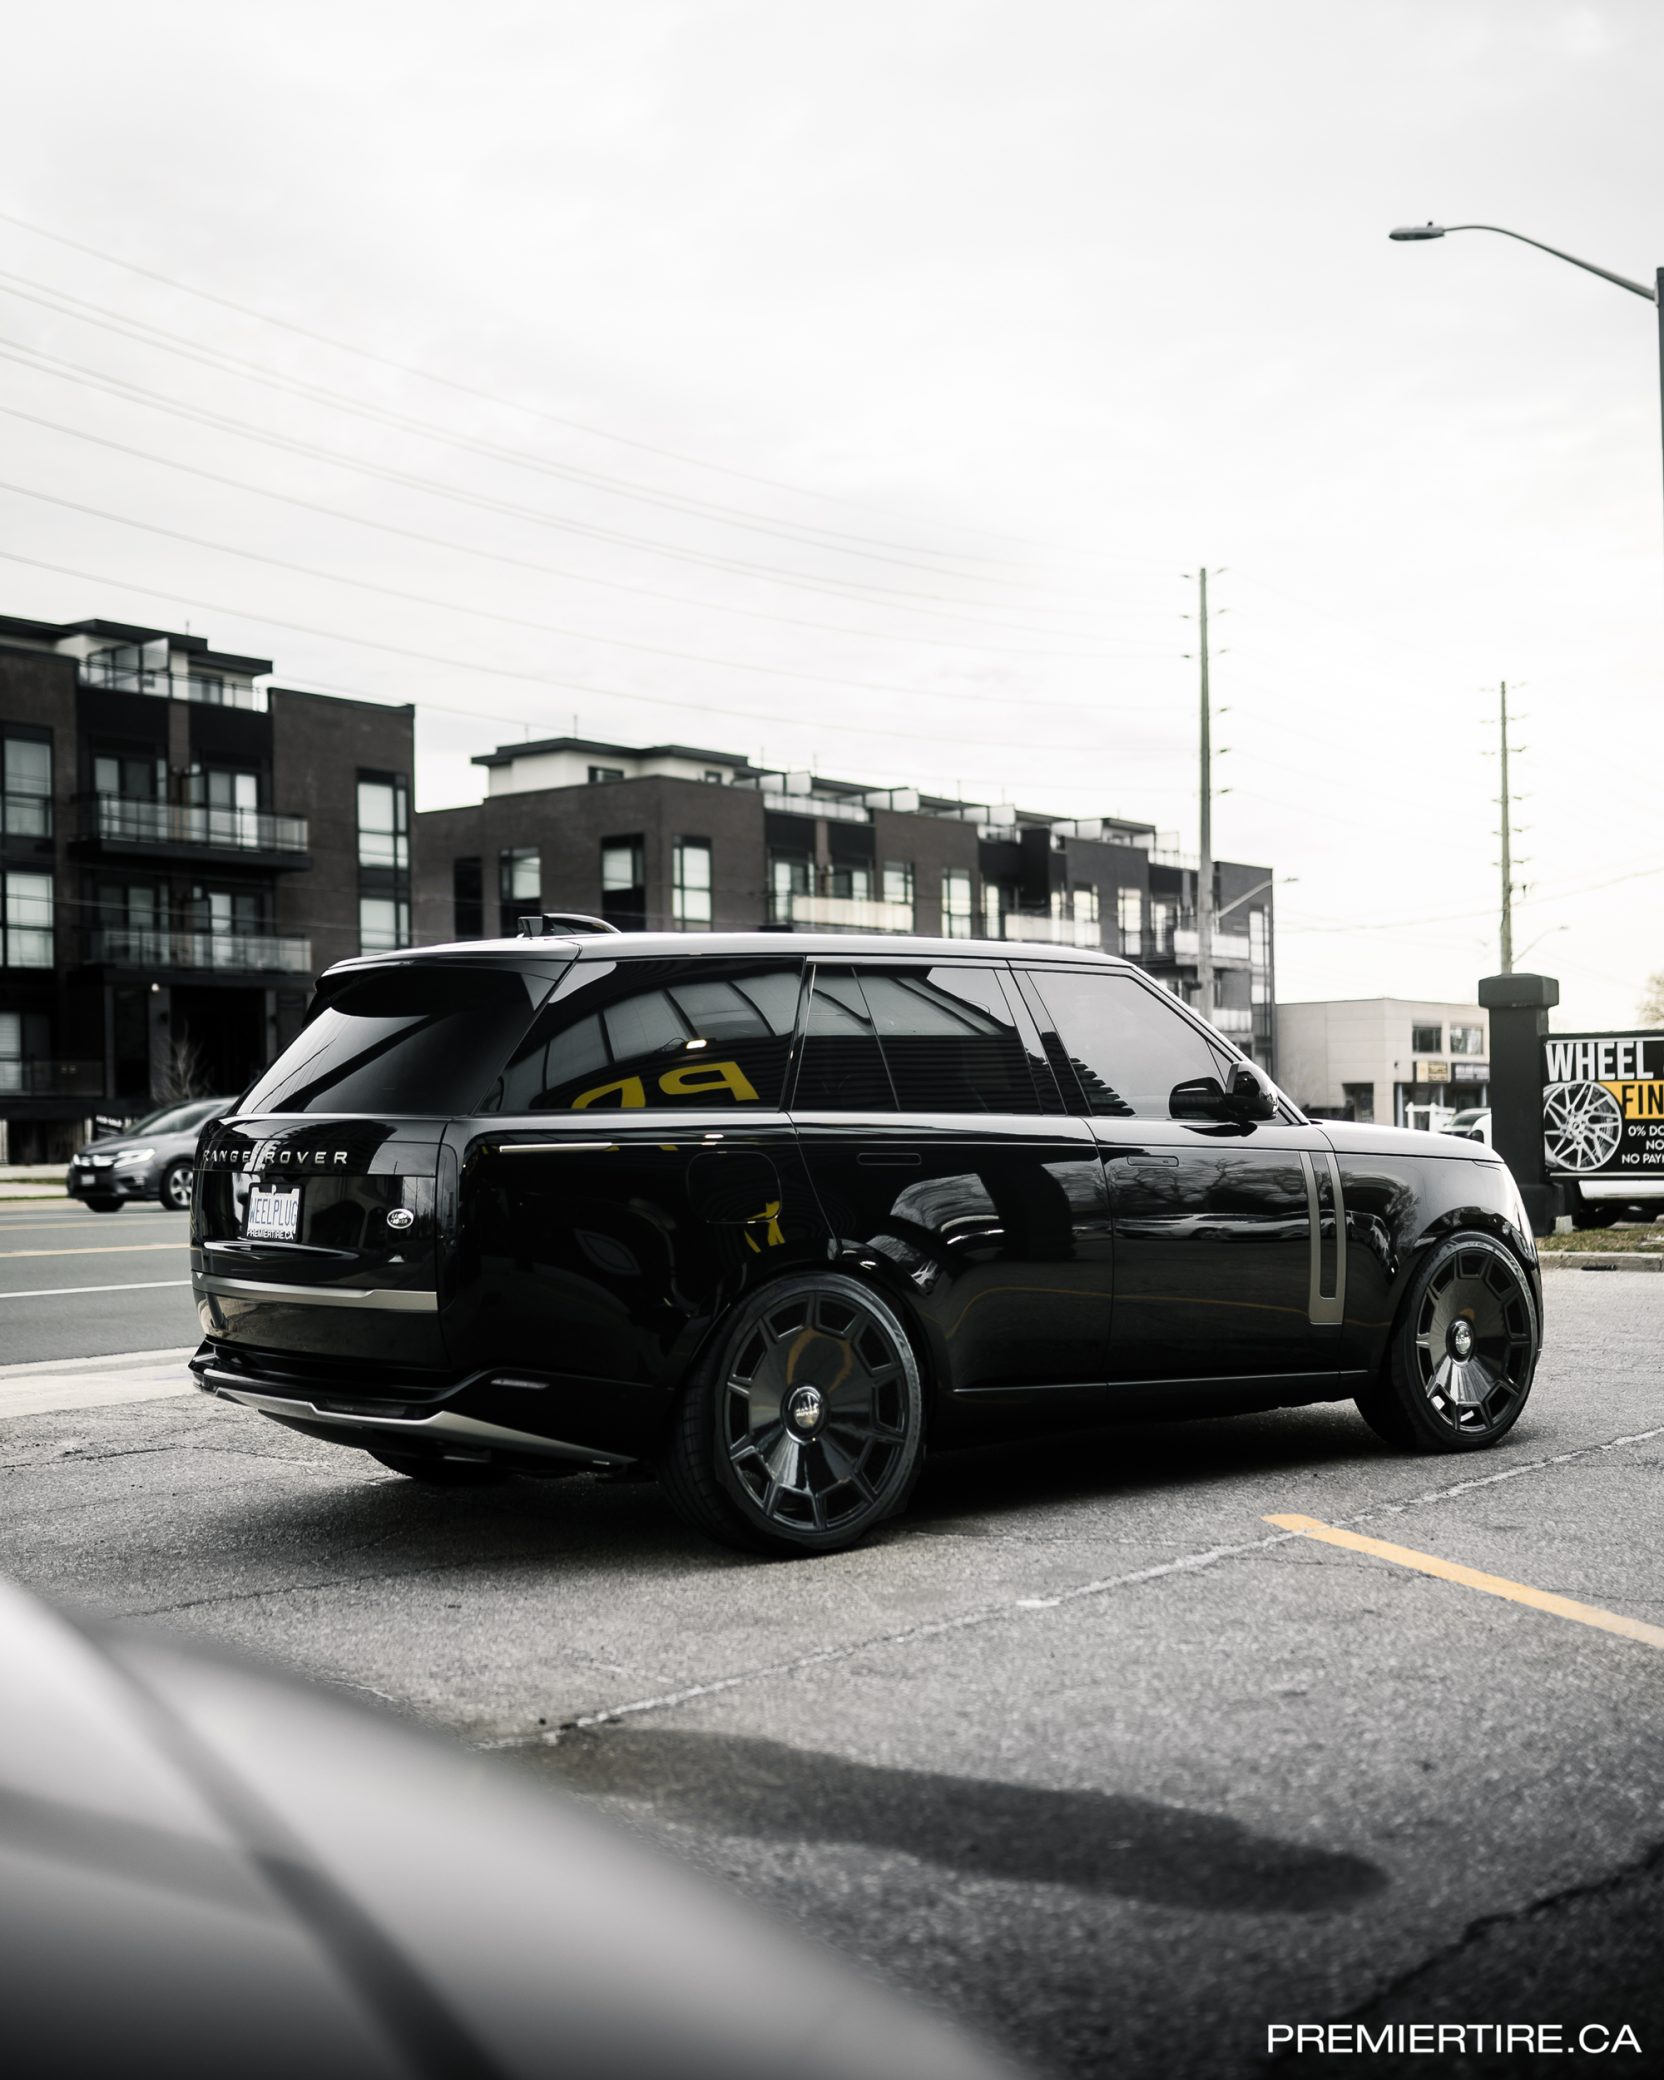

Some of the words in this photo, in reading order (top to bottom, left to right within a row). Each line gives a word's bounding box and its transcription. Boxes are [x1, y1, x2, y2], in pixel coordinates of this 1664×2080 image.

[1545, 1041, 1654, 1082] WHEEL
[1622, 1084, 1664, 1115] FIN
[1628, 1125, 1646, 1137] 0%
[1646, 1139, 1664, 1151] NO
[203, 1150, 251, 1162] RANGE
[264, 1151, 348, 1164] ROVER
[1622, 1153, 1640, 1164] NO
[1643, 1153, 1664, 1164] PAY
